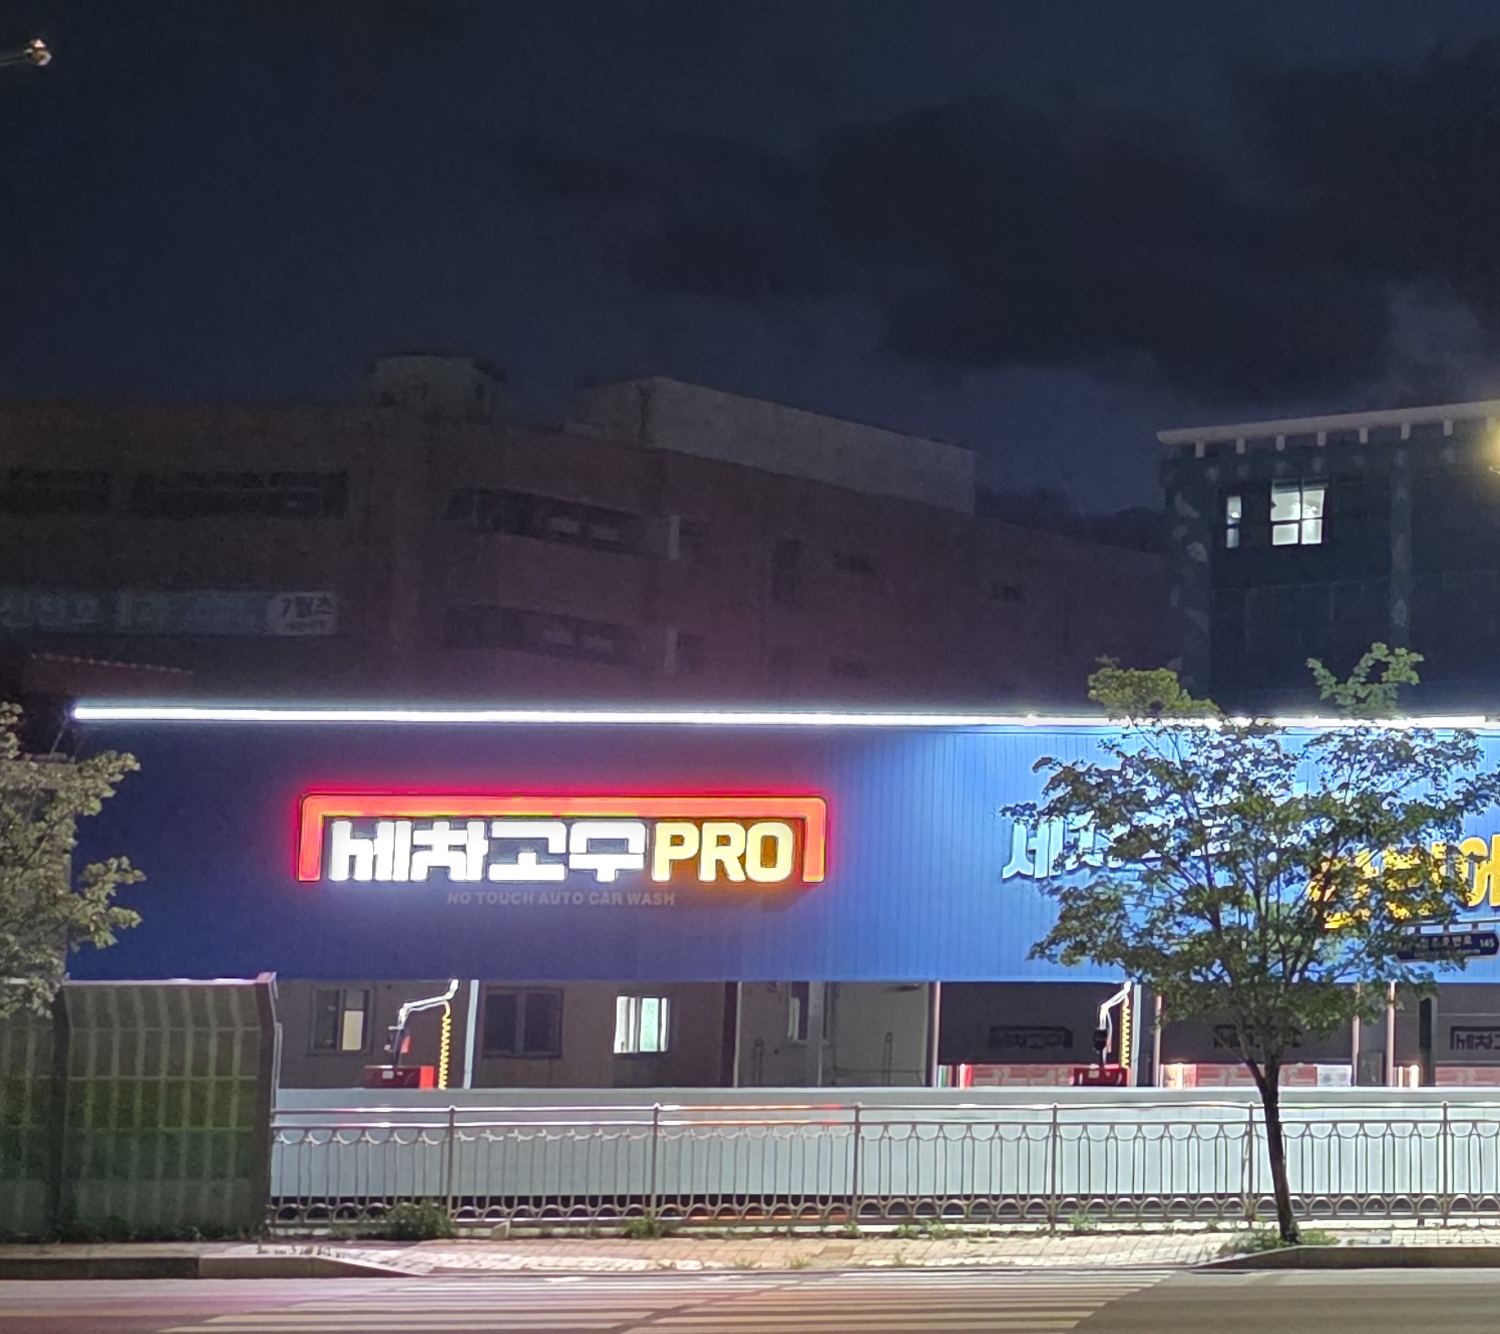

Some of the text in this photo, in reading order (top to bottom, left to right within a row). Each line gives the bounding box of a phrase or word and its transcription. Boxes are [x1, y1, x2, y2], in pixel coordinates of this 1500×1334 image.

[327, 818, 796, 883] 세차고우 PRO
[447, 892, 676, 906] NO TOUCH AUTO CAR WASH
[1479, 937, 1495, 948] 145
